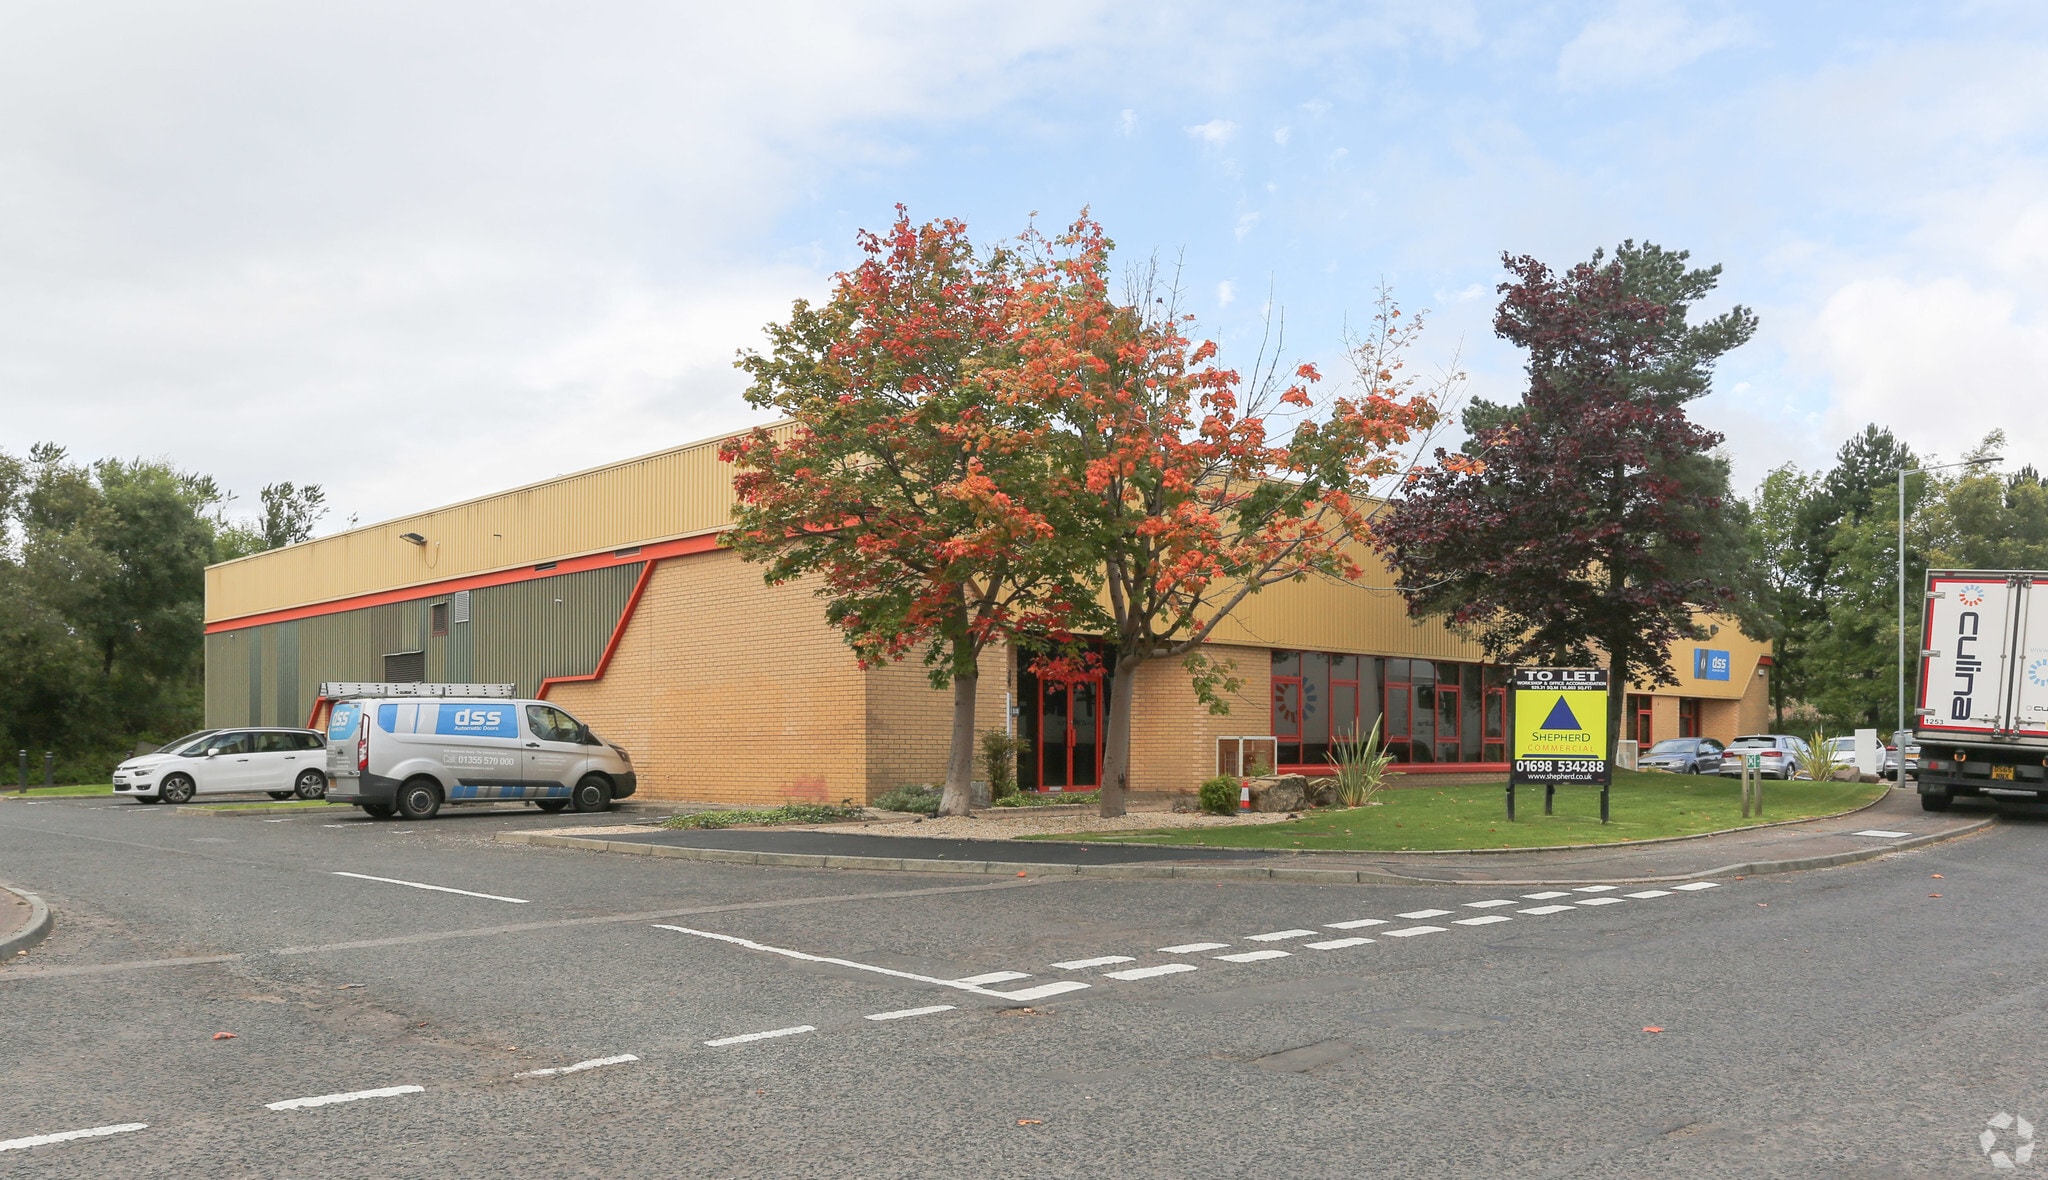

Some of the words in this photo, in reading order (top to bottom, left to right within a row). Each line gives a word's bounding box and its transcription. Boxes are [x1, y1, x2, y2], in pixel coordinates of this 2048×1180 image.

[1712, 656, 1726, 669] dss
[1951, 611, 1981, 720] culina
[1525, 671, 1553, 681] TO
[1563, 671, 1599, 681] LET
[332, 710, 350, 726] dss
[455, 708, 501, 725] dss
[1527, 744, 1594, 752] COMMERCIAL
[458, 755, 482, 764] 01355
[484, 757, 499, 765] 570
[499, 757, 514, 766] 000
[1516, 761, 1553, 772] 01698
[1557, 761, 1605, 773] 534288
